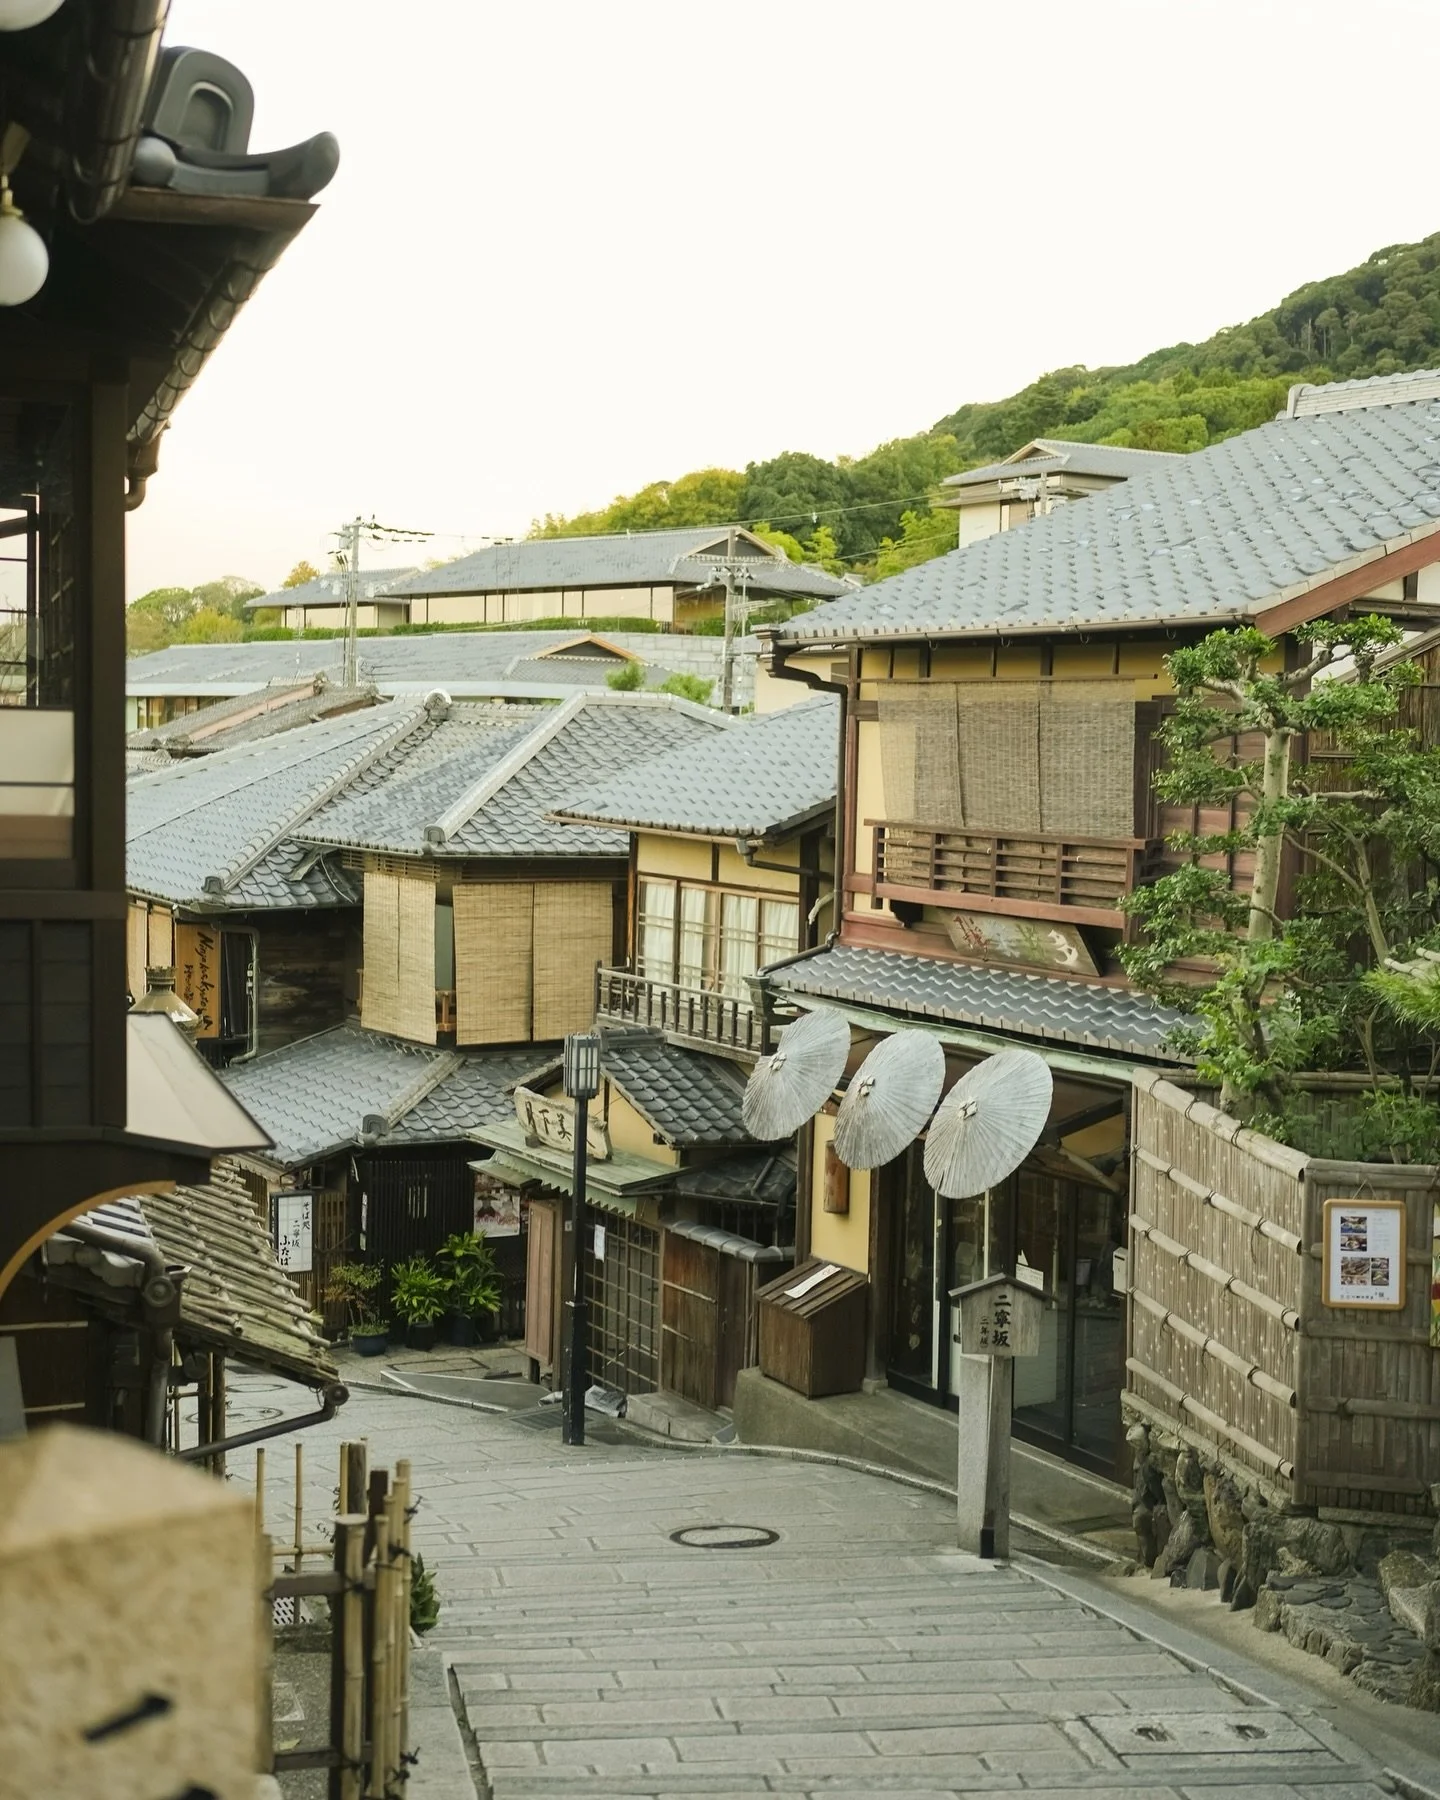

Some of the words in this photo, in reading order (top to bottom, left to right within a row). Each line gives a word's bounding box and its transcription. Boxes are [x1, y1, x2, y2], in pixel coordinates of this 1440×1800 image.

[302, 1202, 311, 1230] そば処
[280, 1235, 291, 1266] ふたば
[992, 1295, 1011, 1347] 二寧坂
